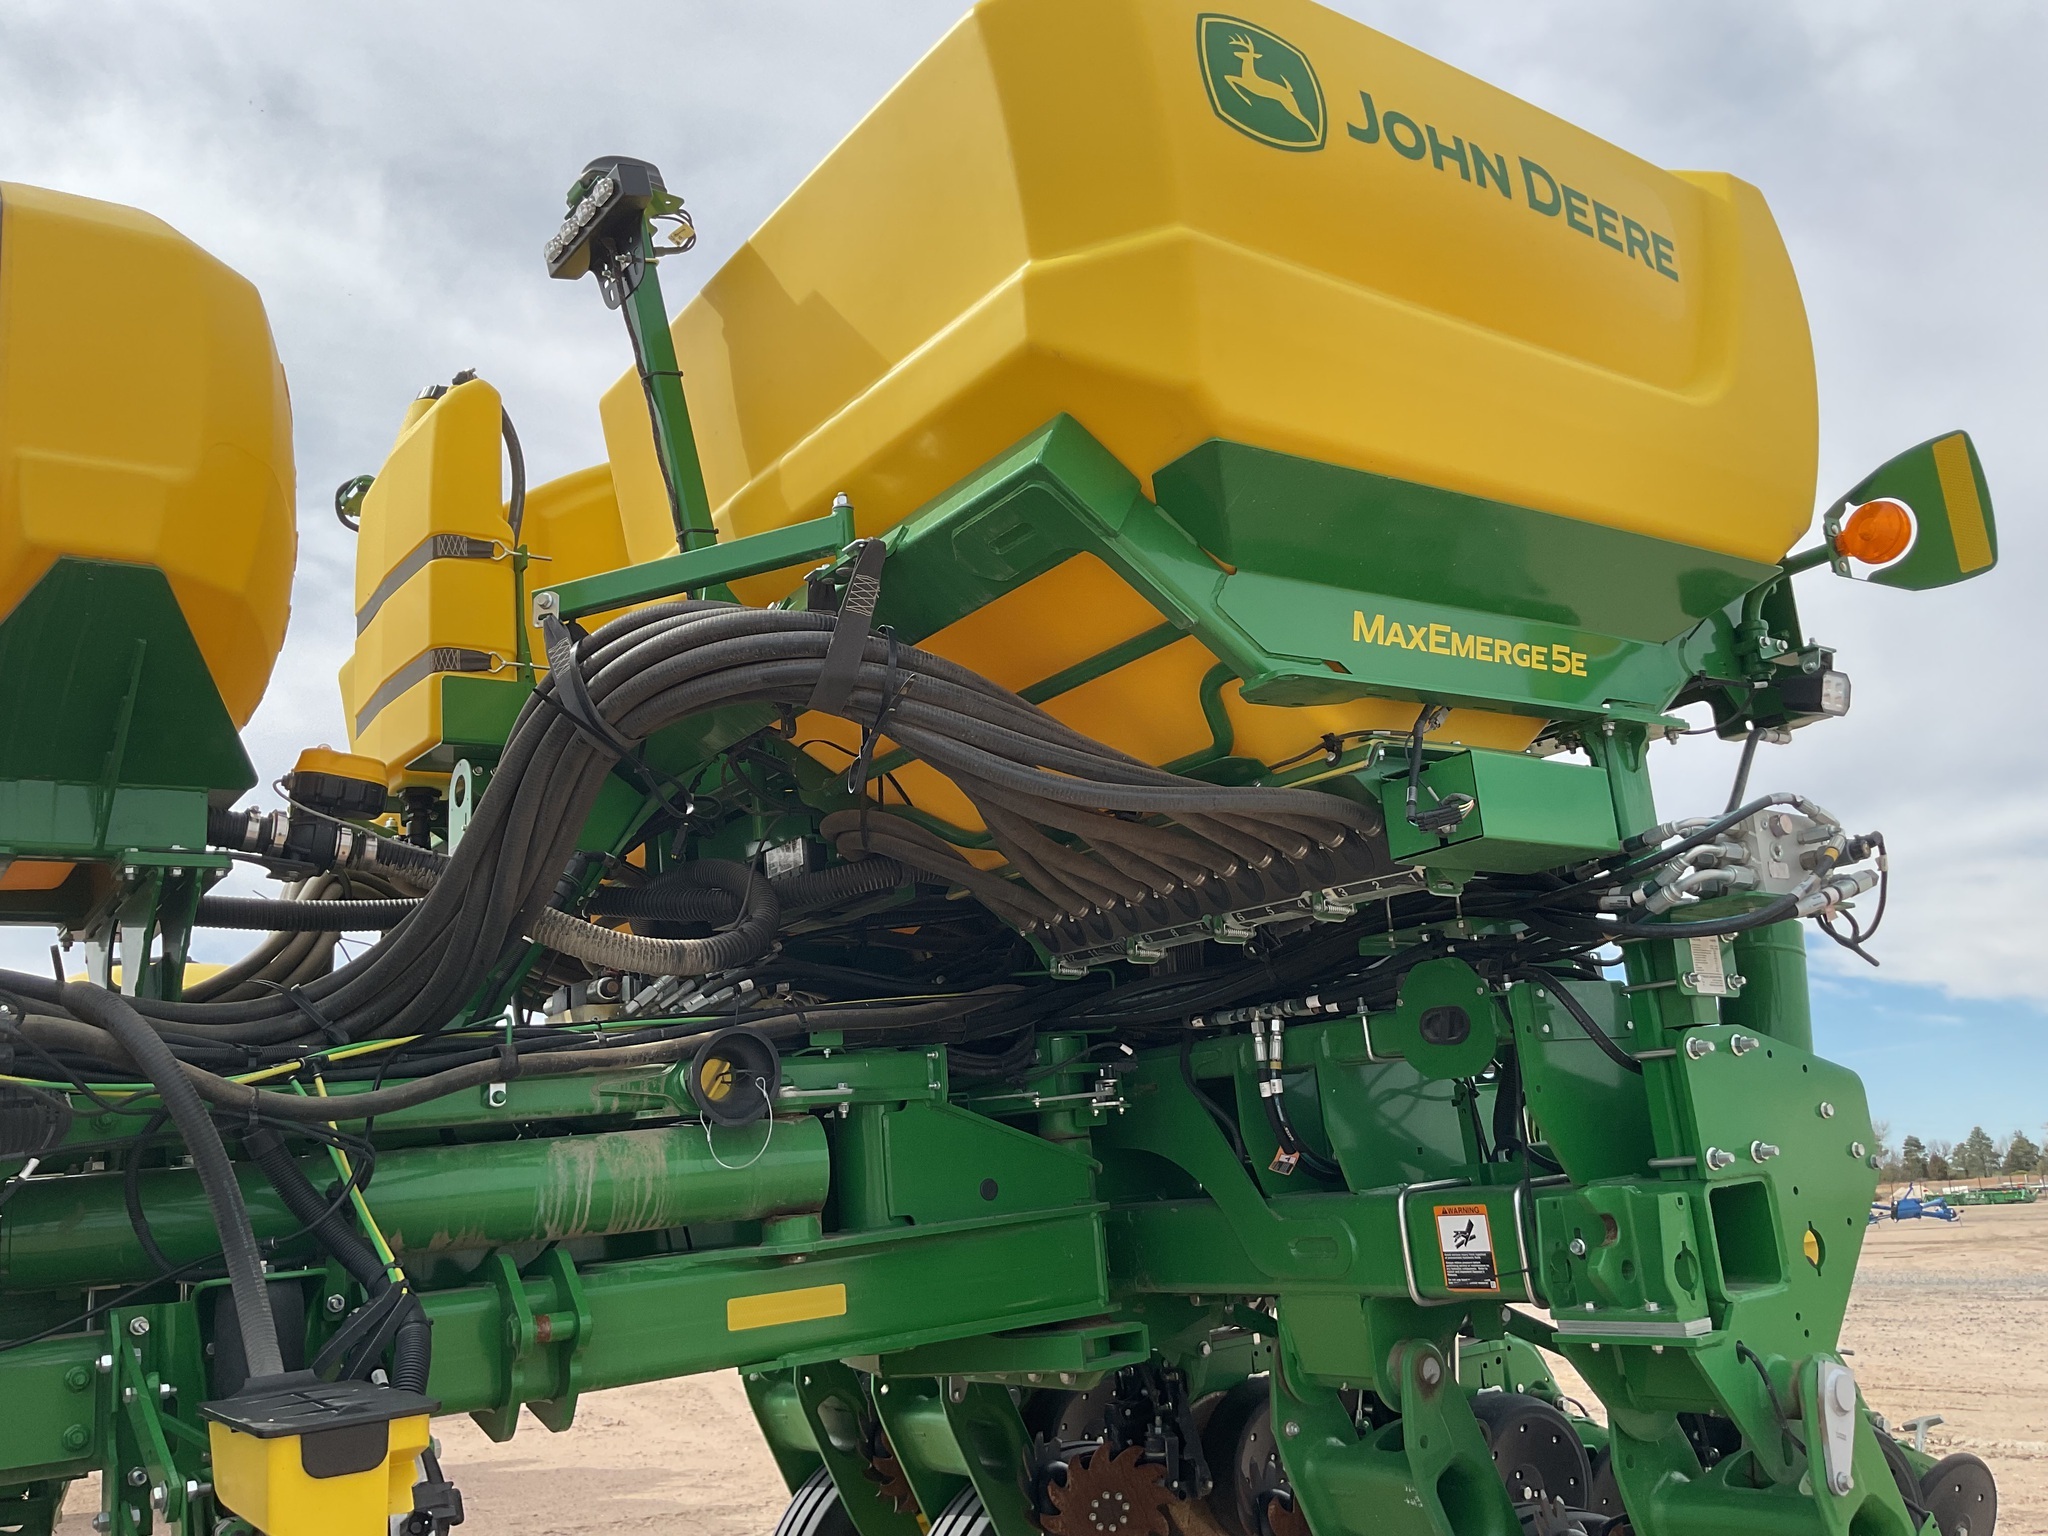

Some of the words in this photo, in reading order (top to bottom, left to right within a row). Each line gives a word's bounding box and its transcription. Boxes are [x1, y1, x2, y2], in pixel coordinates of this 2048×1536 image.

[1347, 90, 1512, 200] JOHN
[1518, 155, 1679, 282] DEERE
[1337, 887, 1348, 897] 3
[1371, 880, 1383, 891] 2
[1408, 873, 1418, 883] 1
[1236, 912, 1245, 921] 6
[1265, 906, 1275, 915] 5
[1297, 899, 1305, 908] 4
[1144, 934, 1154, 942] 9
[1170, 928, 1180, 937] 8
[1447, 1206, 1480, 1214] WARNING
